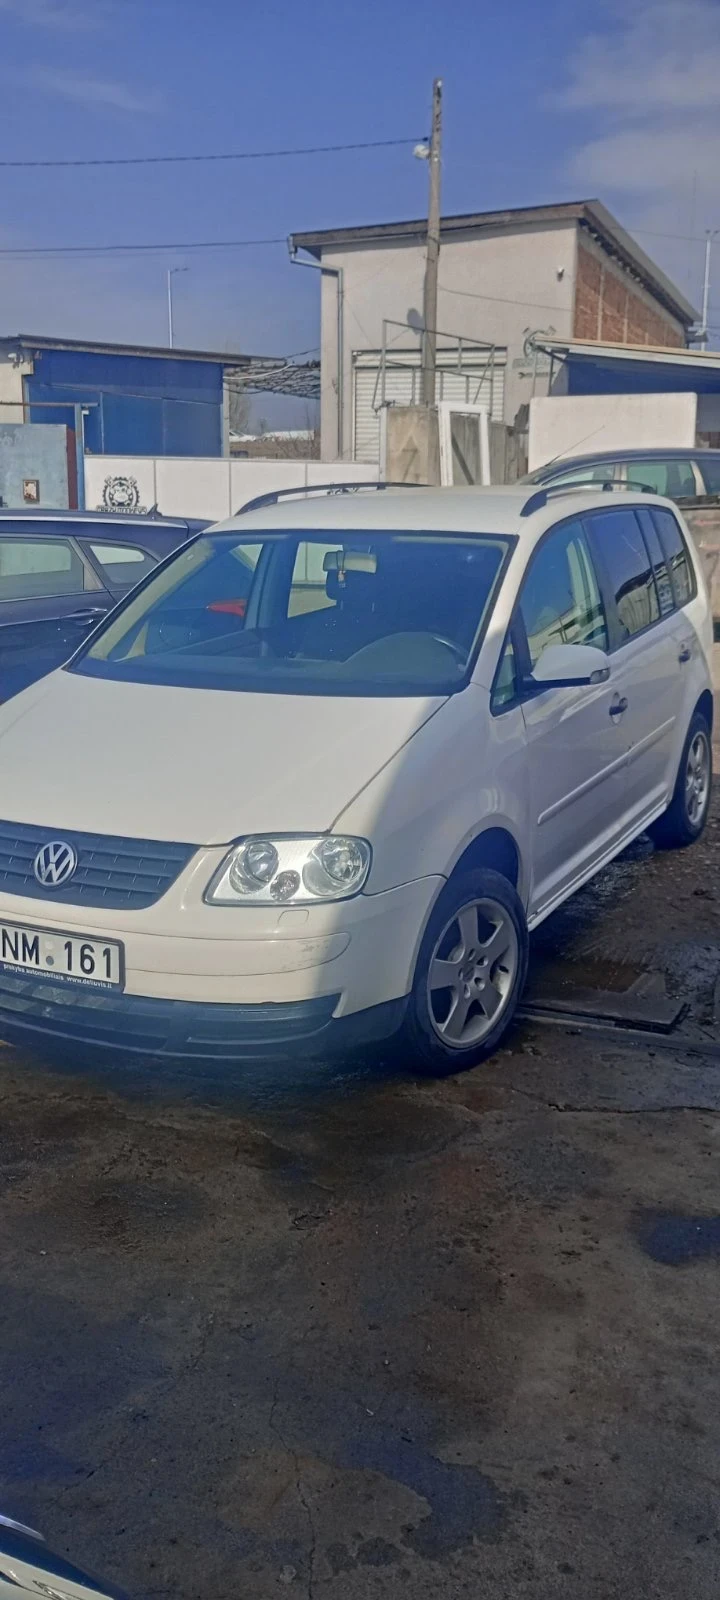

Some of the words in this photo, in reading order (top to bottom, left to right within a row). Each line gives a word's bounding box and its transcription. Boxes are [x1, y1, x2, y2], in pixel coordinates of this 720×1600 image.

[35, 841, 75, 887] VW
[1, 928, 40, 965] NM
[64, 941, 112, 978] 161
